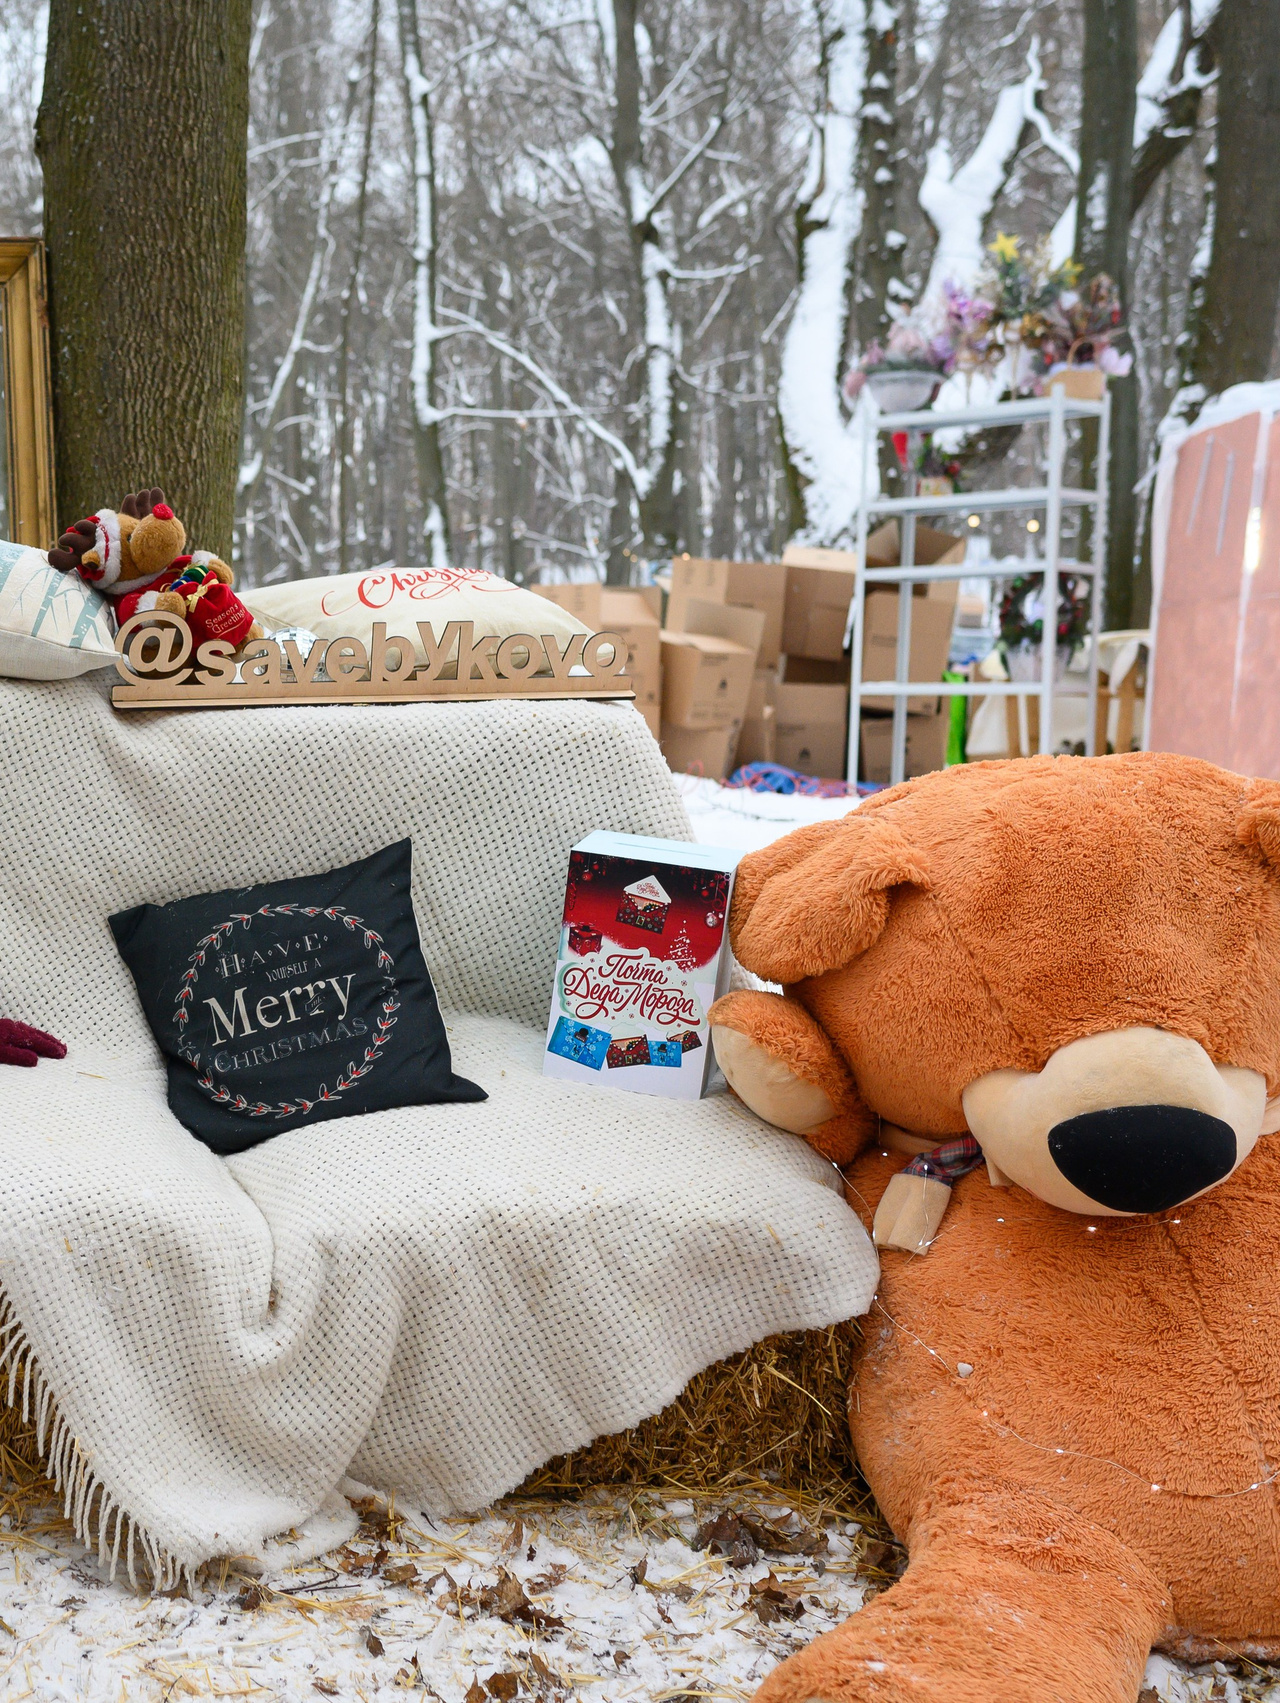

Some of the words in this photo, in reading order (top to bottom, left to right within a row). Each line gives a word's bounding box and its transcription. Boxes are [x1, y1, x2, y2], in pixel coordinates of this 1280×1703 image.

[265, 960, 308, 982] YOURSELF
[314, 957, 322, 968] A
[563, 967, 624, 1020] Деда
[612, 978, 701, 1027] Мороза
[598, 953, 668, 985] Почта
[203, 973, 357, 1046] Merry
[214, 1017, 369, 1073] CHRISTMAS
